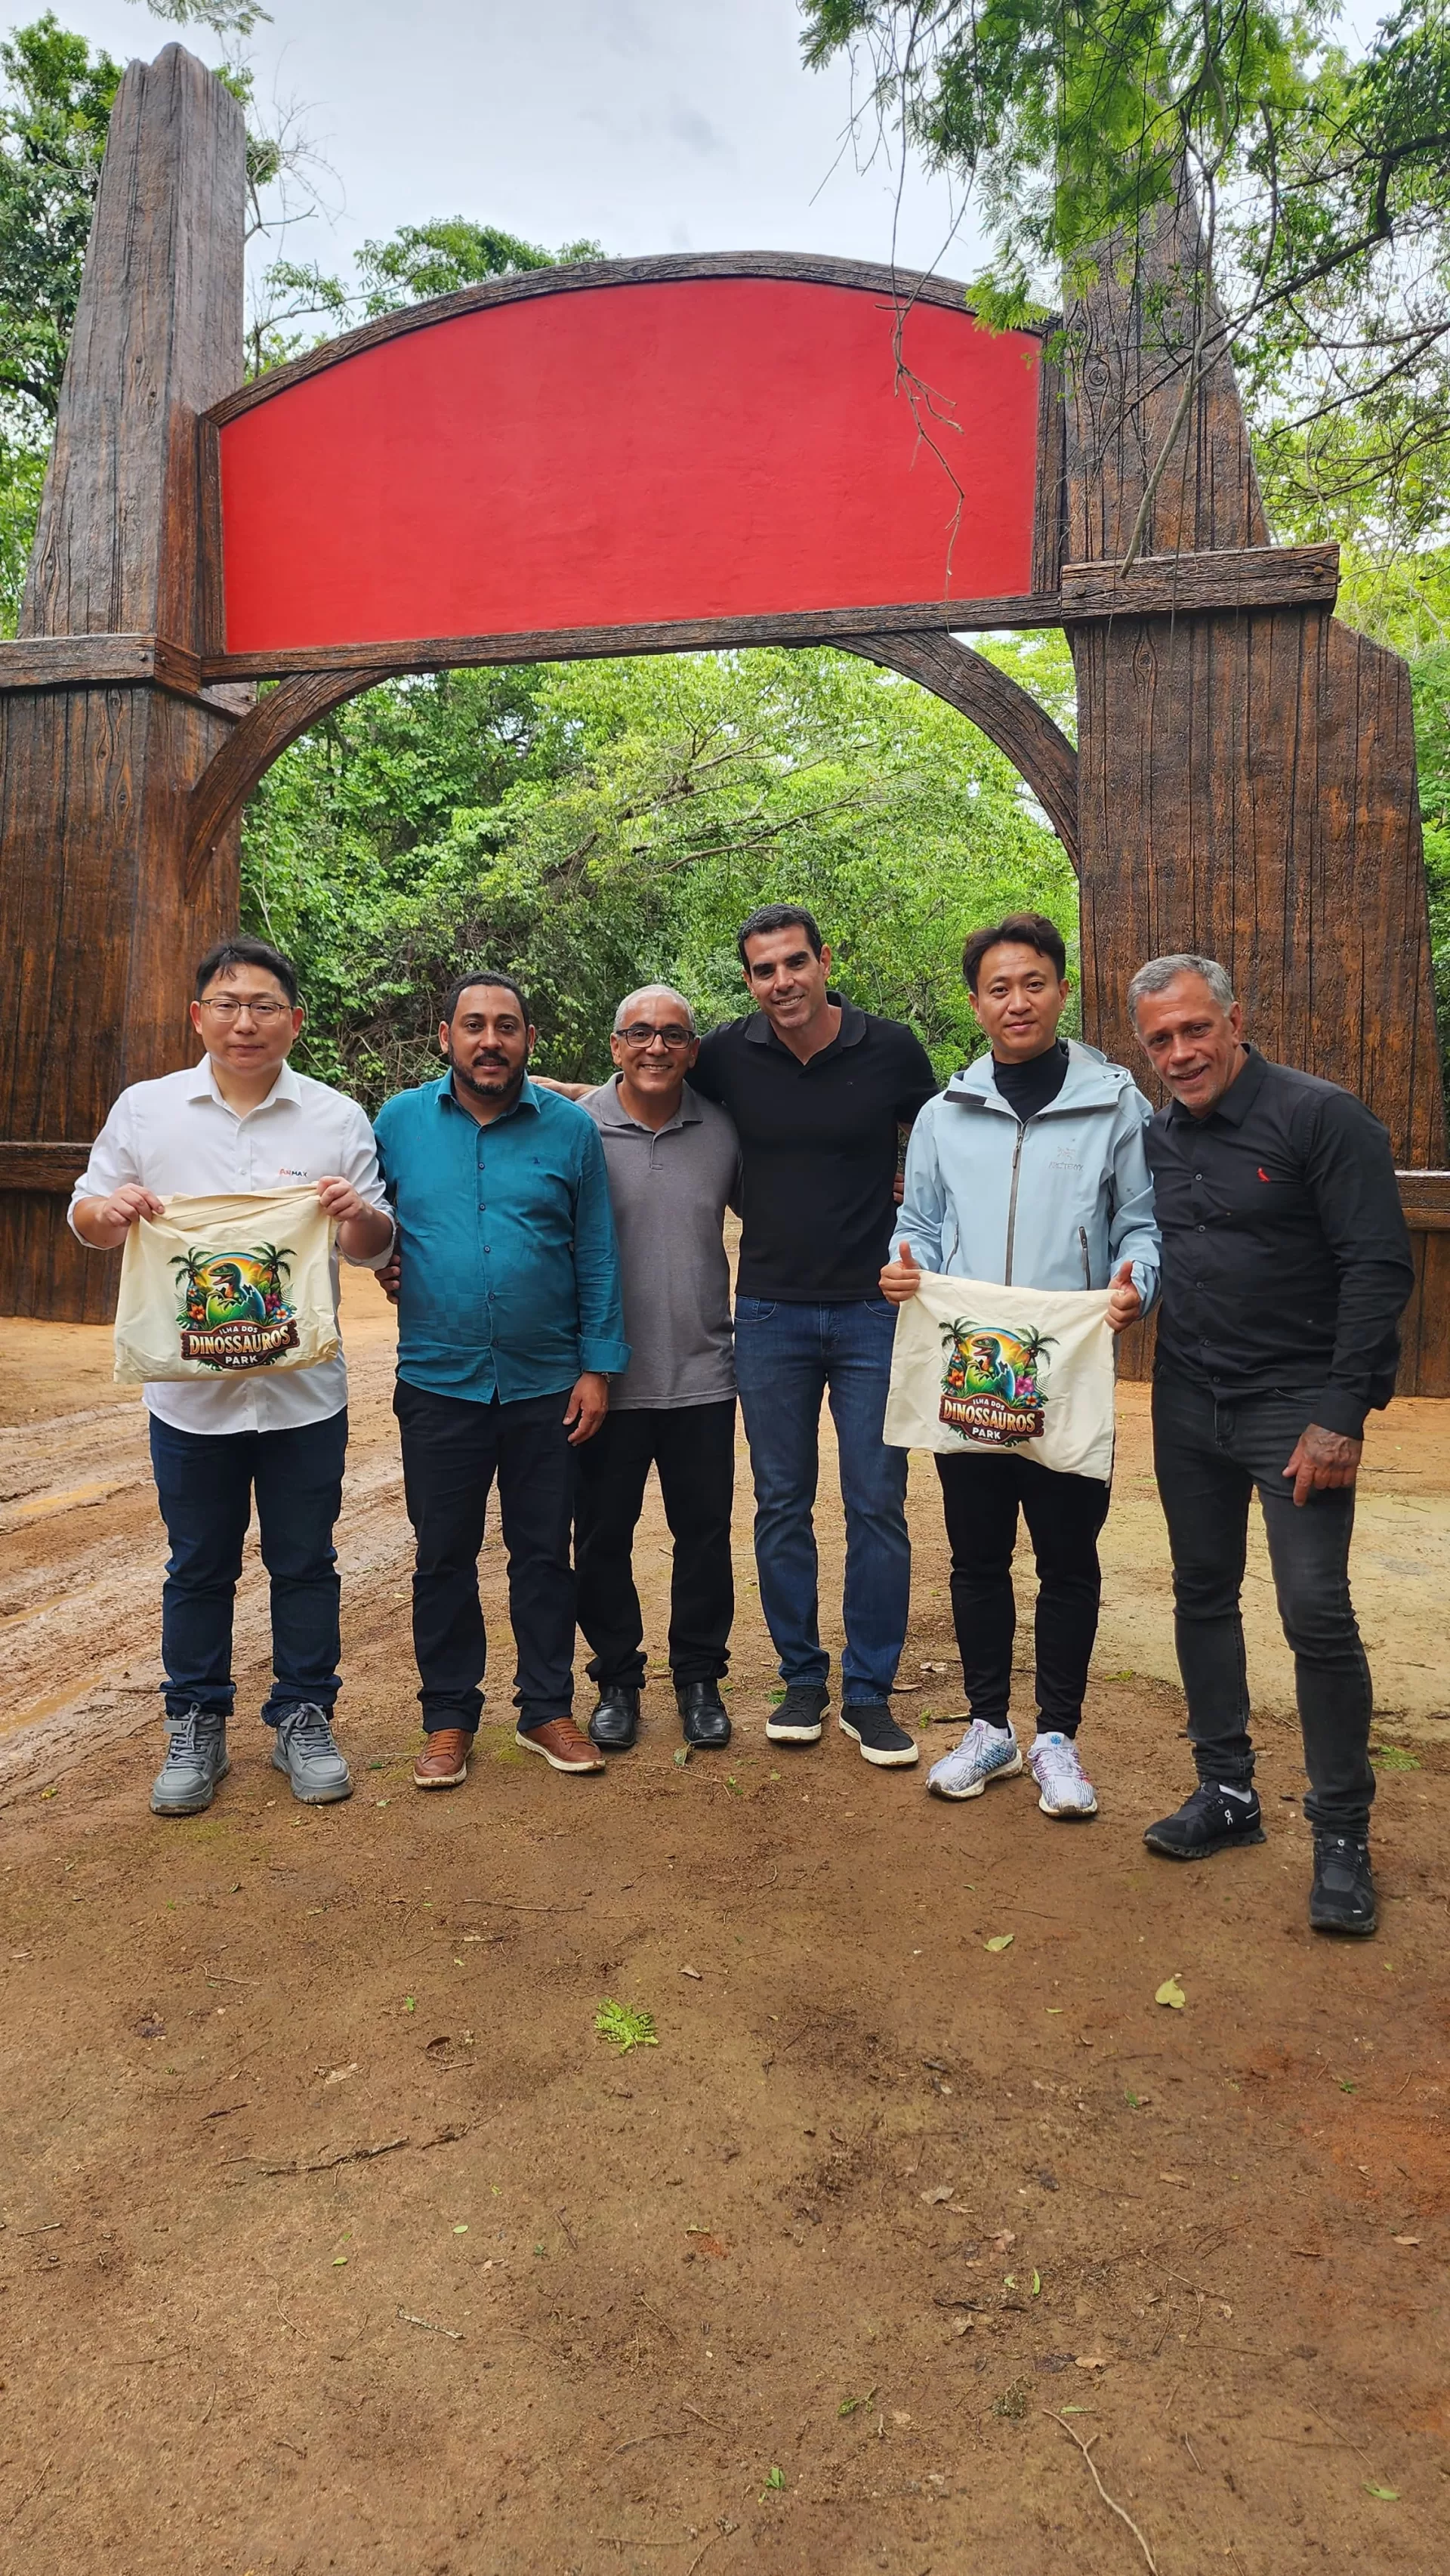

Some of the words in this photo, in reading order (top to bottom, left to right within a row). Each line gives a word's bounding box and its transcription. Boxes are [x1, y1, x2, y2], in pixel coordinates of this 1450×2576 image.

[219, 1325, 239, 1335] ILHA
[189, 1326, 291, 1355] DINOSSAUROS
[225, 1354, 258, 1365] PARK
[991, 1401, 1005, 1411] DOS
[943, 1399, 1036, 1432] DINOSSAUROS
[972, 1426, 1001, 1440] PARK
